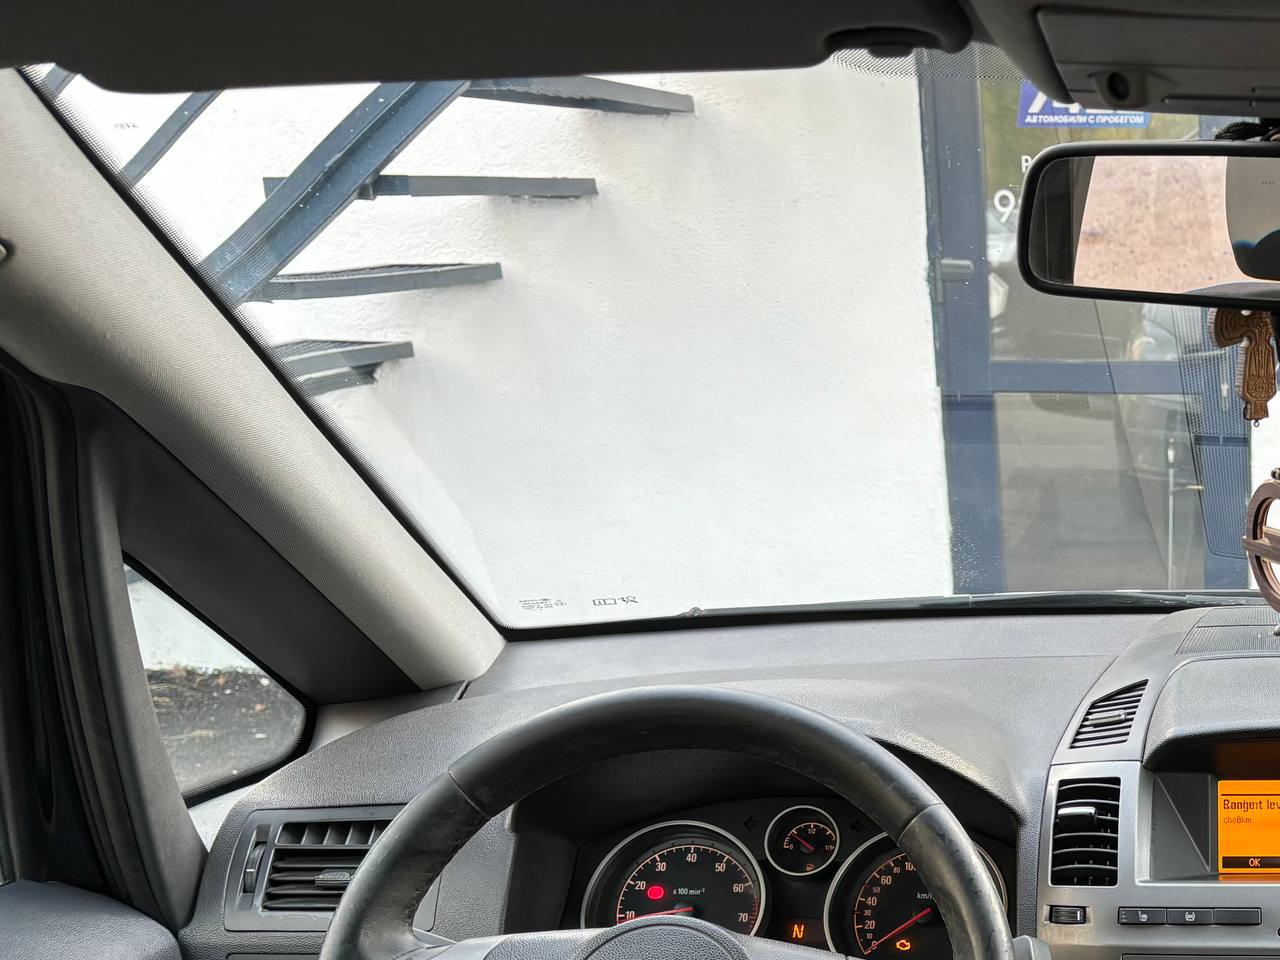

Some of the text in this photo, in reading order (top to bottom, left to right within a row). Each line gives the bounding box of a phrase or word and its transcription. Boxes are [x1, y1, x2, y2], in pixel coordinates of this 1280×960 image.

[686, 853, 697, 863] 40
[1248, 858, 1261, 867] OK
[655, 862, 667, 872] 30
[715, 863, 726, 872] 50
[880, 875, 892, 885] 60
[634, 880, 646, 891] 20
[733, 883, 744, 893] 60
[866, 896, 877, 906] 40
[626, 910, 635, 919] 10
[738, 912, 748, 922] 70
[864, 919, 875, 930] 20
[793, 923, 804, 939] N
